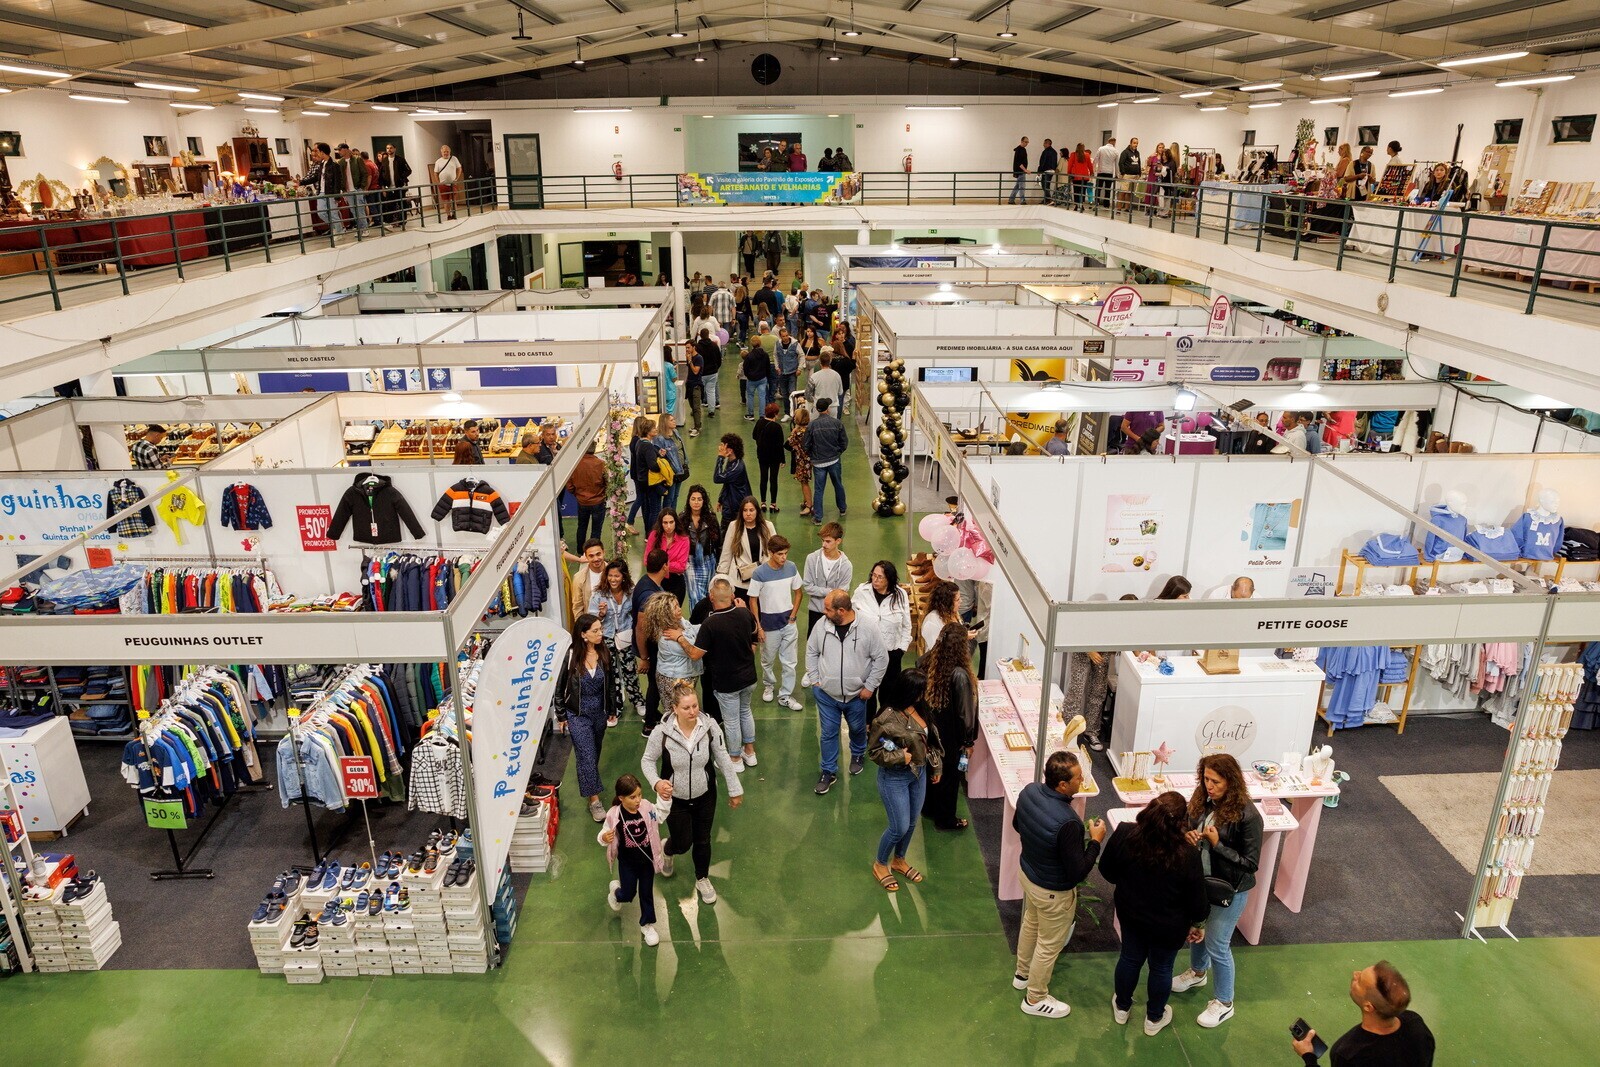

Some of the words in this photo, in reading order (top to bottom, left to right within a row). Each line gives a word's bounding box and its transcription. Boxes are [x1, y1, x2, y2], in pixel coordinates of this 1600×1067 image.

[298, 508, 329, 516] PROMOÇÕES
[304, 539, 334, 548] PROMOÇÕES
[1535, 532, 1551, 546] M
[1257, 621, 1301, 630] PETITE
[1305, 620, 1348, 628] GOOSE
[124, 637, 209, 646] PEUGUINHAS
[213, 636, 263, 646] OUTLET
[1202, 720, 1252, 746] Glintt
[347, 778, 374, 792] -30%
[148, 808, 168, 819] -50
[170, 811, 180, 820] %
